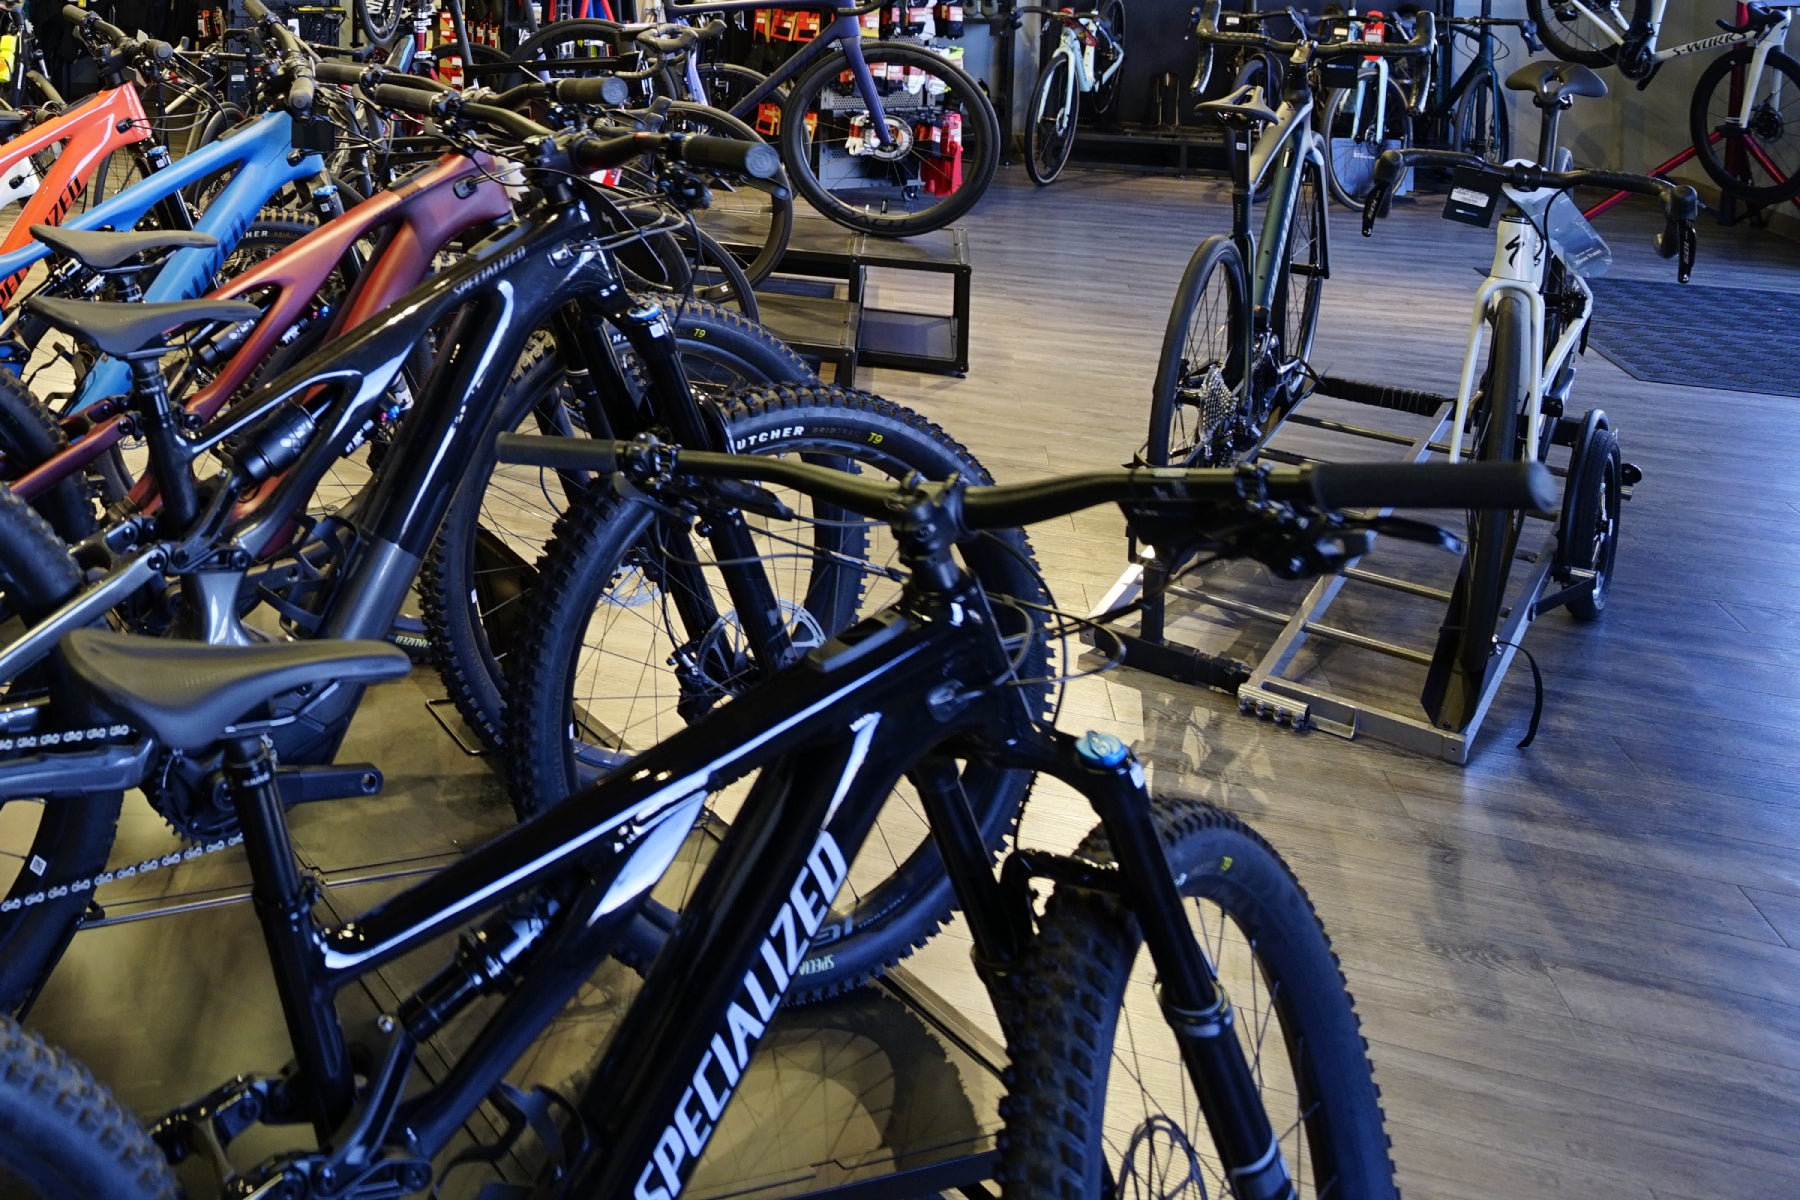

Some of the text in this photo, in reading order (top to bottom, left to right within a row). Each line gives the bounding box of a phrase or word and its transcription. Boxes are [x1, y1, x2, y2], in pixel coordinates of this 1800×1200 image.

[453, 245, 526, 296] SPECIALIZED
[694, 328, 706, 338] T9
[736, 425, 805, 450] UTCHER
[867, 432, 884, 445] T9
[633, 829, 849, 1200] SPECIALIZED
